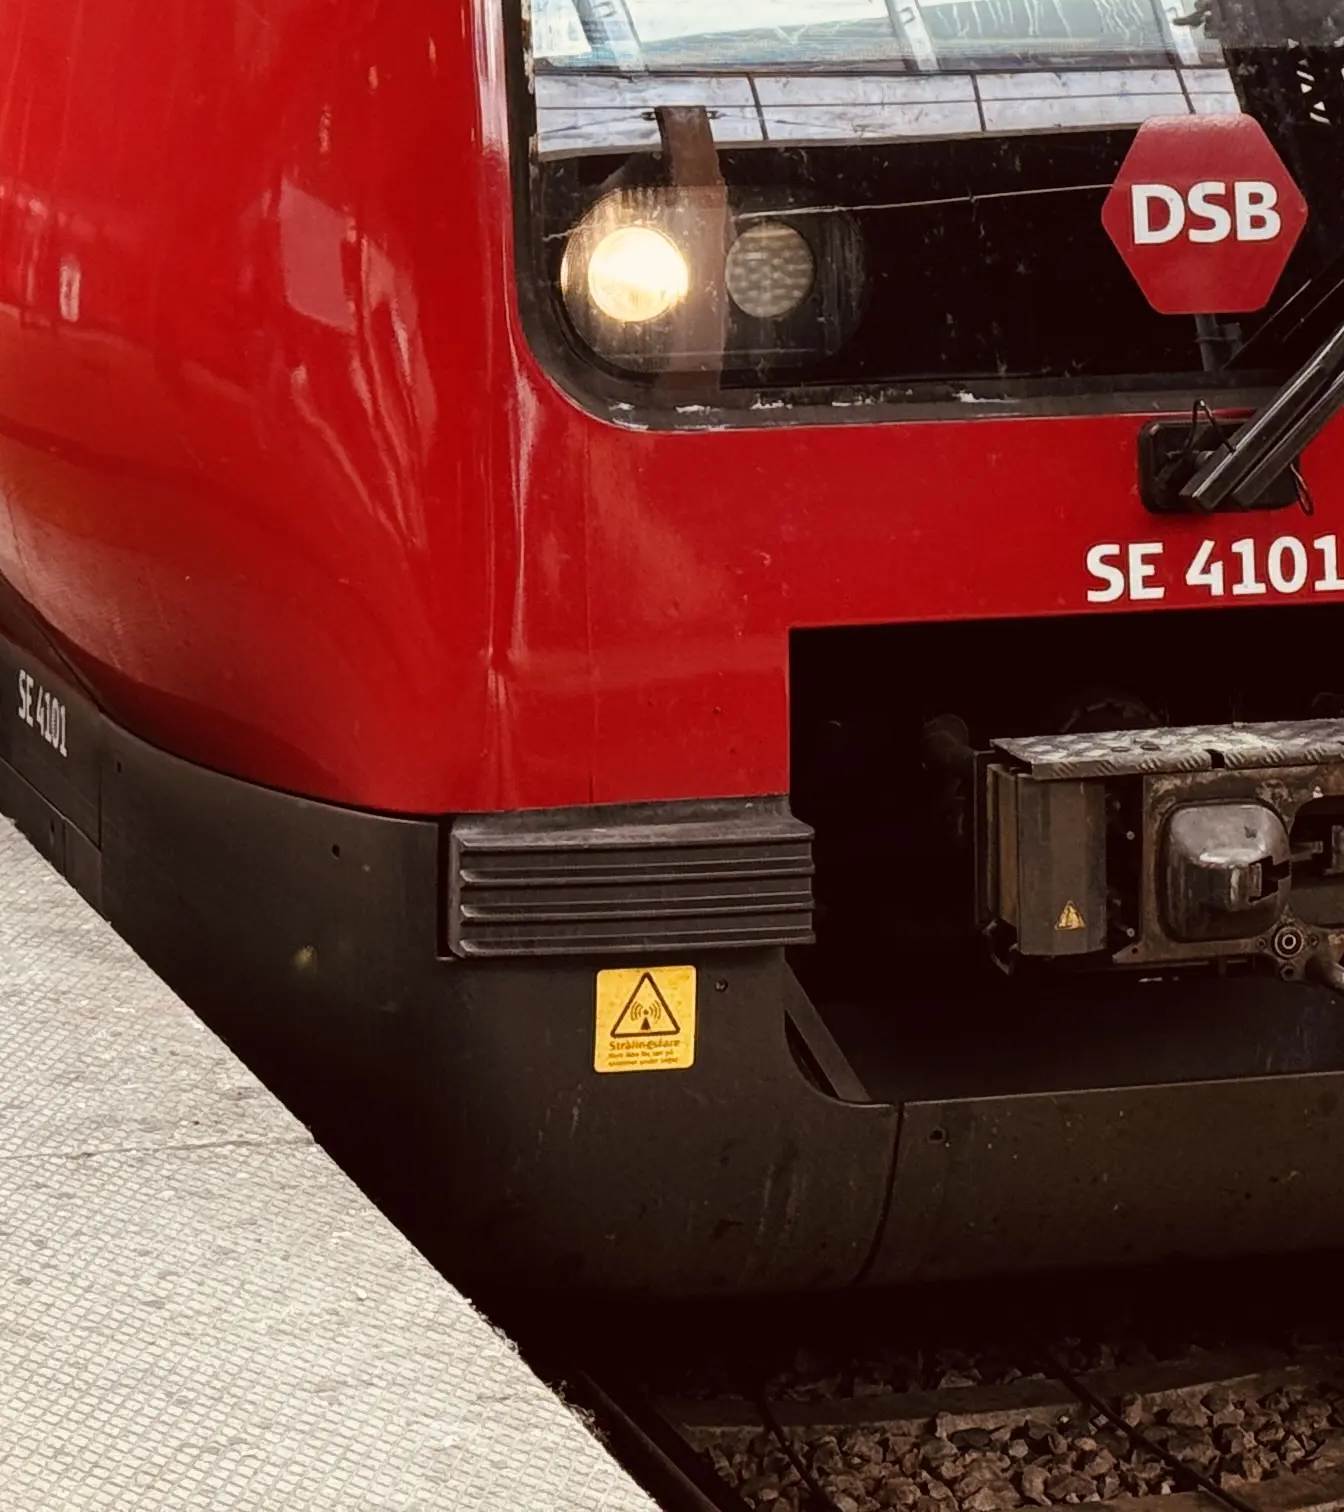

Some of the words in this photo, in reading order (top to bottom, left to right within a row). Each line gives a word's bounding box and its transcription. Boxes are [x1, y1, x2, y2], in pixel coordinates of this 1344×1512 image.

[1131, 181, 1282, 245] DSB
[1086, 542, 1165, 603] SE
[18, 669, 35, 727] SE
[36, 685, 67, 758] 4101
